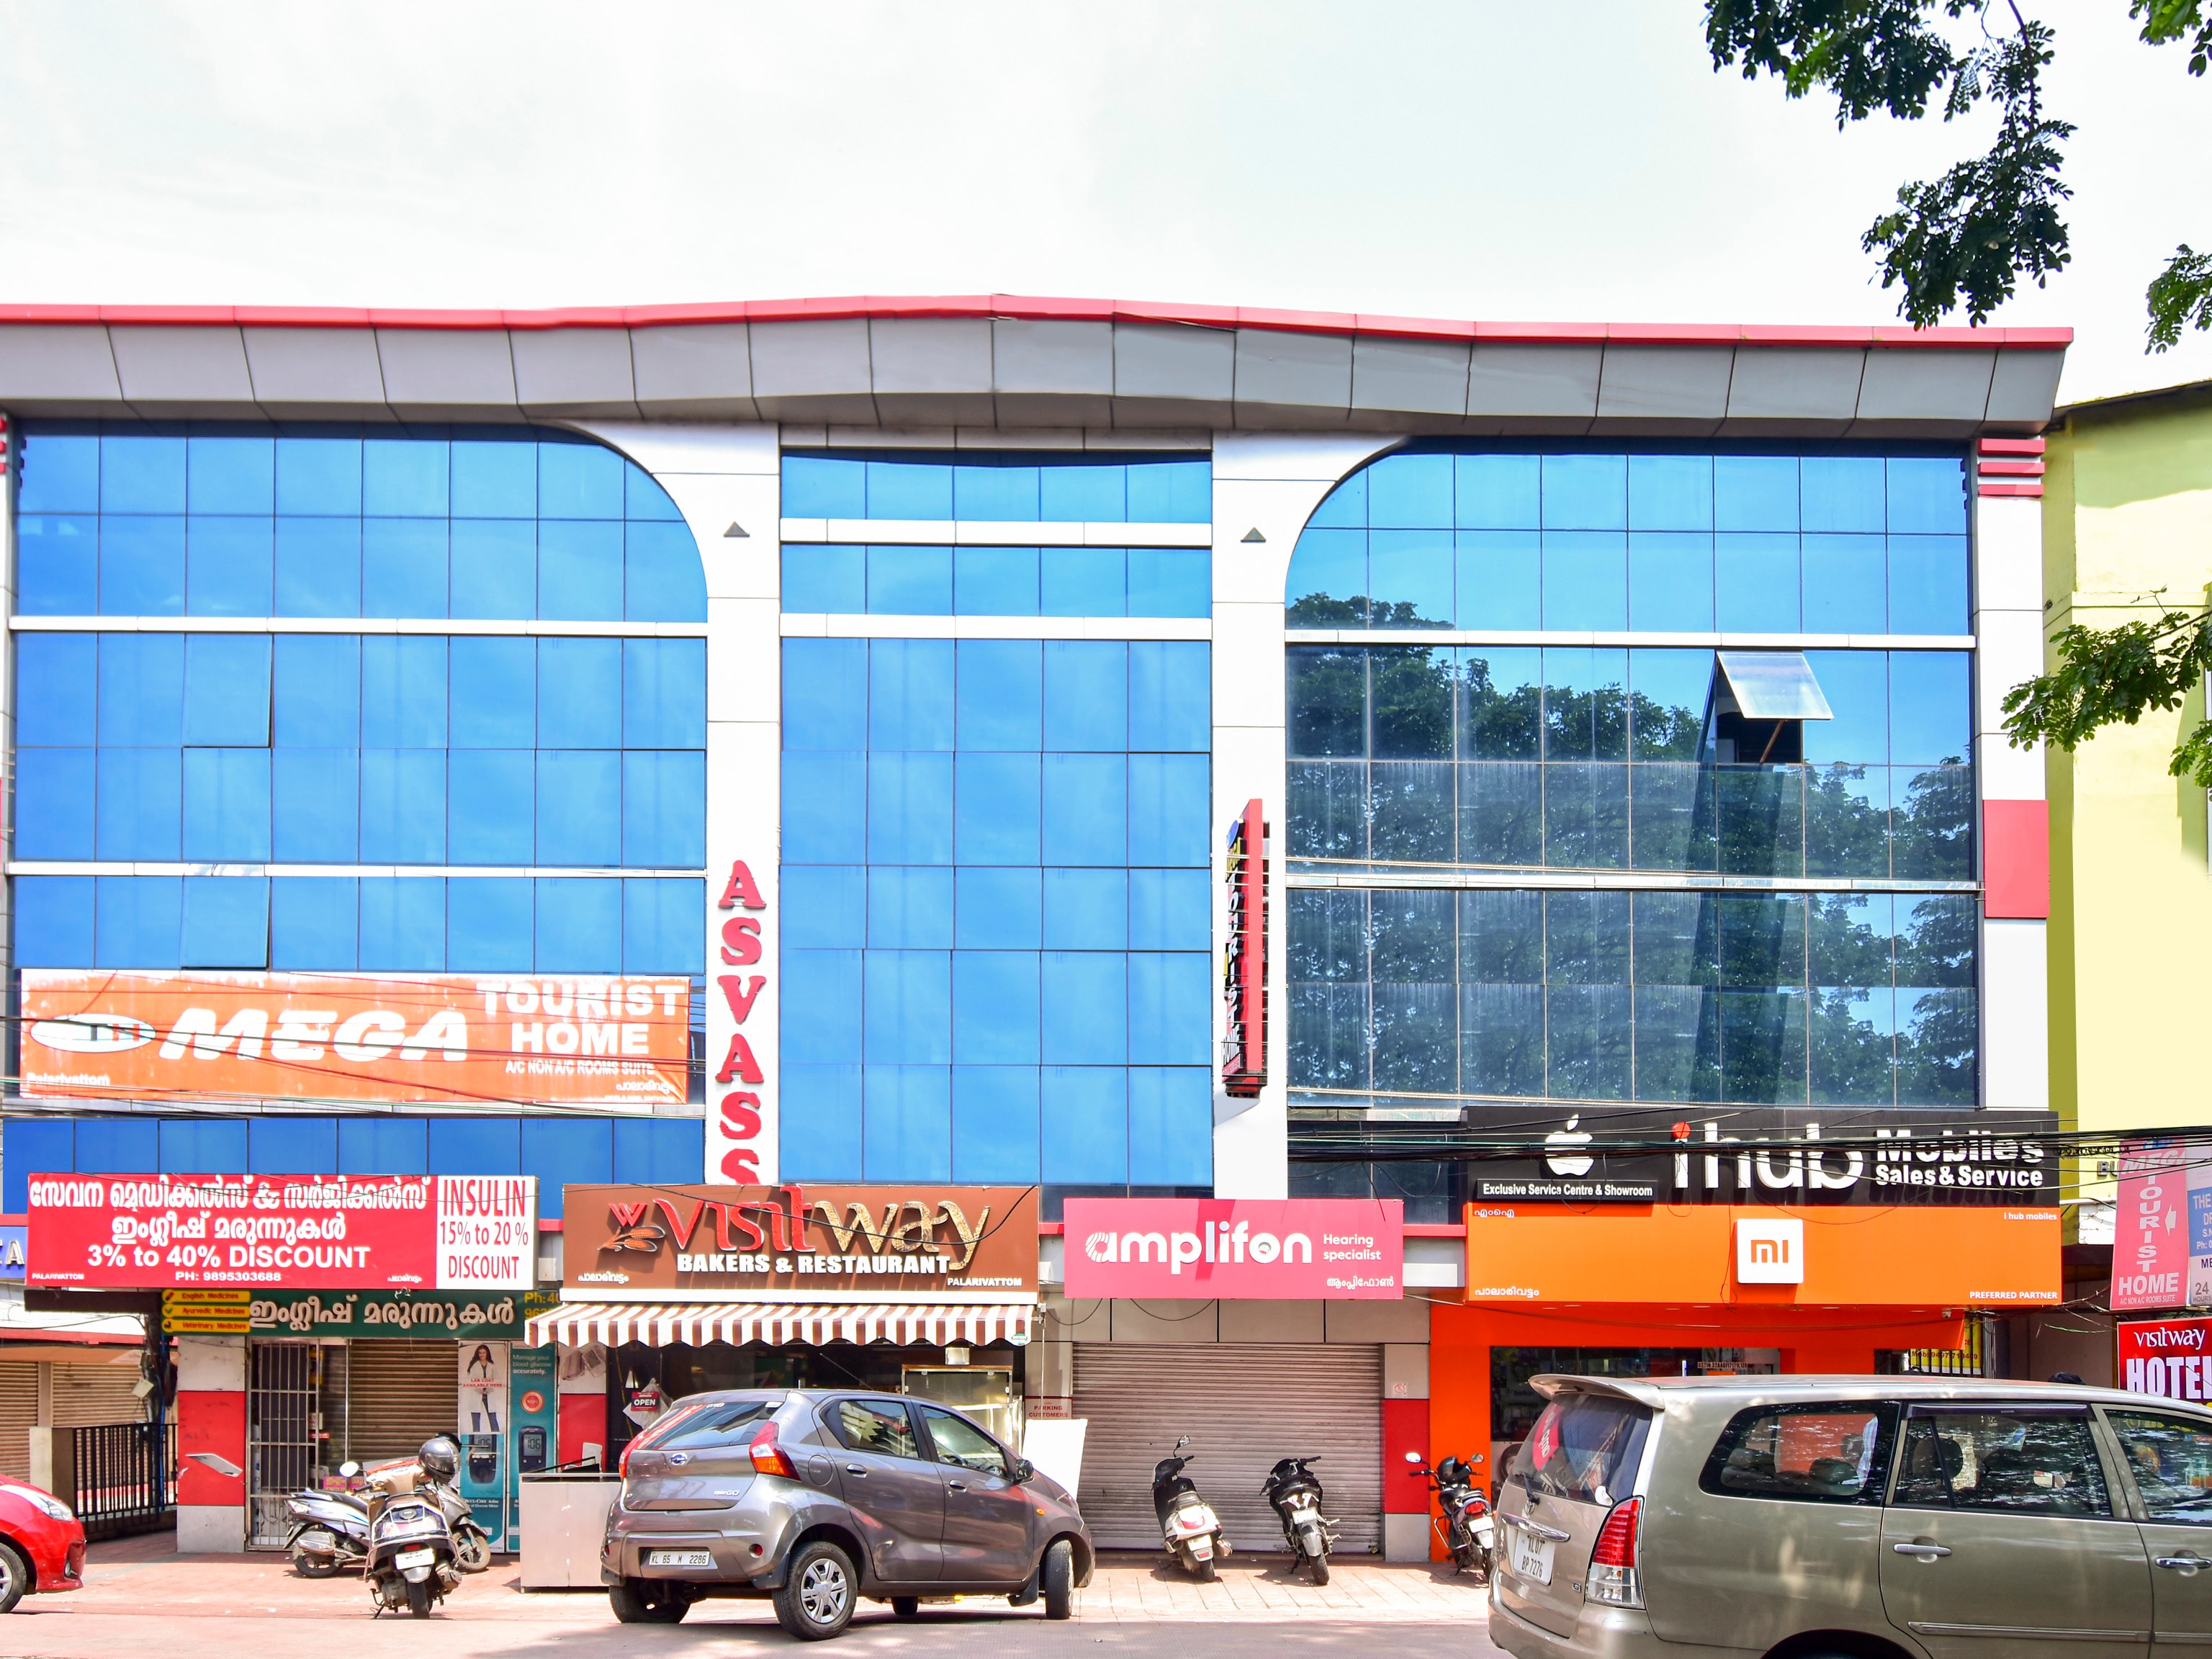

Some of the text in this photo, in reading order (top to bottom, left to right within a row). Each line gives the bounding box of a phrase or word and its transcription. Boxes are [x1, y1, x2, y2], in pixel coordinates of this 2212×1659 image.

[476, 983, 685, 1017] TOURIST
[158, 1008, 468, 1061] MEGA
[511, 1022, 649, 1054] HOME
[505, 1061, 655, 1076] A/C NON A/C ROOMS SUITE
[1875, 1164, 1936, 1185] Sales
[1958, 1165, 2044, 1186] Service
[30, 1181, 104, 1208] സേവന
[253, 1182, 280, 1210] &
[443, 1179, 526, 1217] INSULIN
[1483, 1184, 1653, 1197] Exclusive Service Centre & Showroom
[2193, 1193, 2211, 1210] THE
[440, 1221, 471, 1245] 15%
[475, 1223, 490, 1245] to
[1323, 1233, 1374, 1248] Hearing
[87, 1244, 371, 1267] 3% to 40% DISCOUNT
[1085, 1220, 1313, 1275] amplifon
[1323, 1249, 1382, 1262] specialist
[448, 1255, 519, 1279] DISCOUNT
[676, 1254, 950, 1274] BAKERS & RESTAURANT
[175, 1272, 282, 1282] PH: 9895303688
[947, 1277, 1022, 1287] PALARIVATTOM
[2118, 1272, 2180, 1296] HOME
[524, 1292, 546, 1304] Ph:
[2195, 1282, 2209, 1295] 24
[249, 1294, 516, 1331] ഇംഗ്ലീഷ് മരുന്നുകൾ
[689, 1555, 706, 1564] 2286
